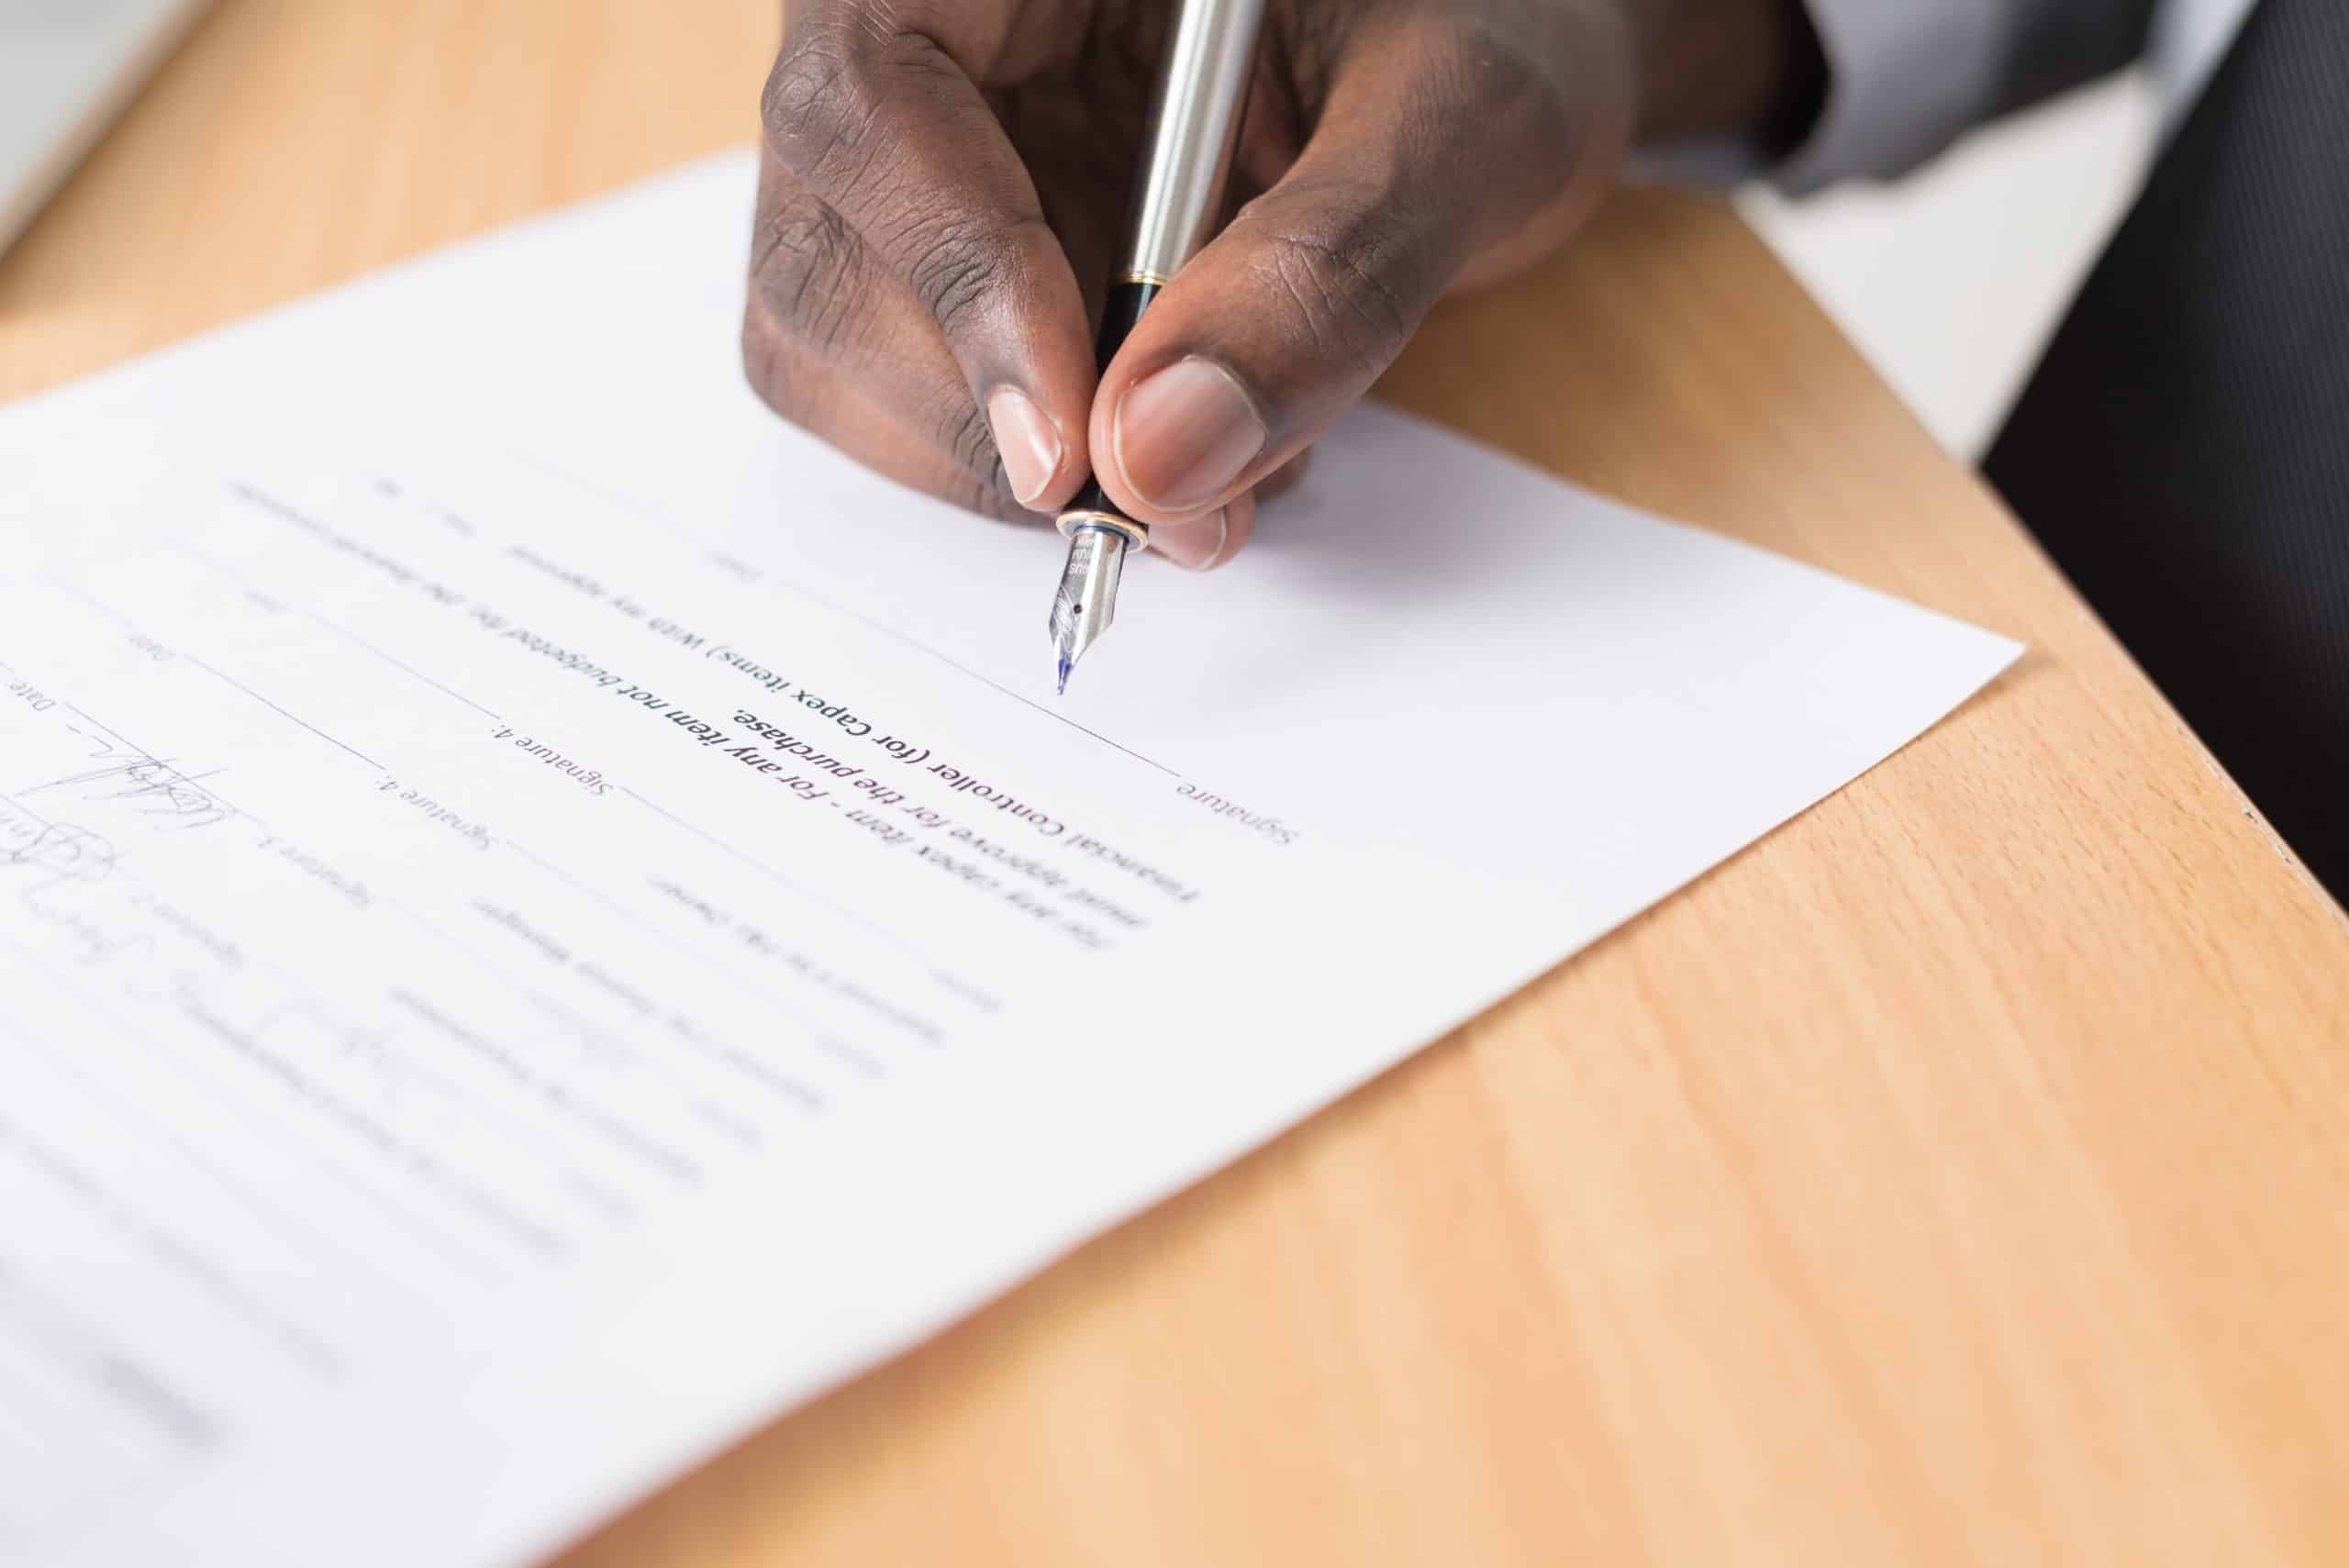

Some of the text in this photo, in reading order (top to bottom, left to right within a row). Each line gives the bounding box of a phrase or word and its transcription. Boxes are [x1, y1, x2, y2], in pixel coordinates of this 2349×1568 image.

[496, 626, 621, 688] budgeted
[644, 615, 707, 651] With
[702, 643, 792, 695] items)
[613, 683, 670, 711] not
[788, 686, 874, 738] Capex
[664, 709, 731, 748] item
[729, 710, 866, 779] purchase.
[868, 732, 932, 766] (for
[511, 733, 615, 797] Signature
[729, 743, 779, 773] any
[777, 772, 830, 802] For
[853, 776, 907, 806] the
[923, 761, 1066, 837] Controller
[1173, 780, 1300, 846] Signature
[395, 786, 496, 851] Signature
[846, 808, 916, 846] item
[900, 803, 952, 830] for
[945, 825, 1069, 889] approve
[1060, 829, 1201, 905] Financial
